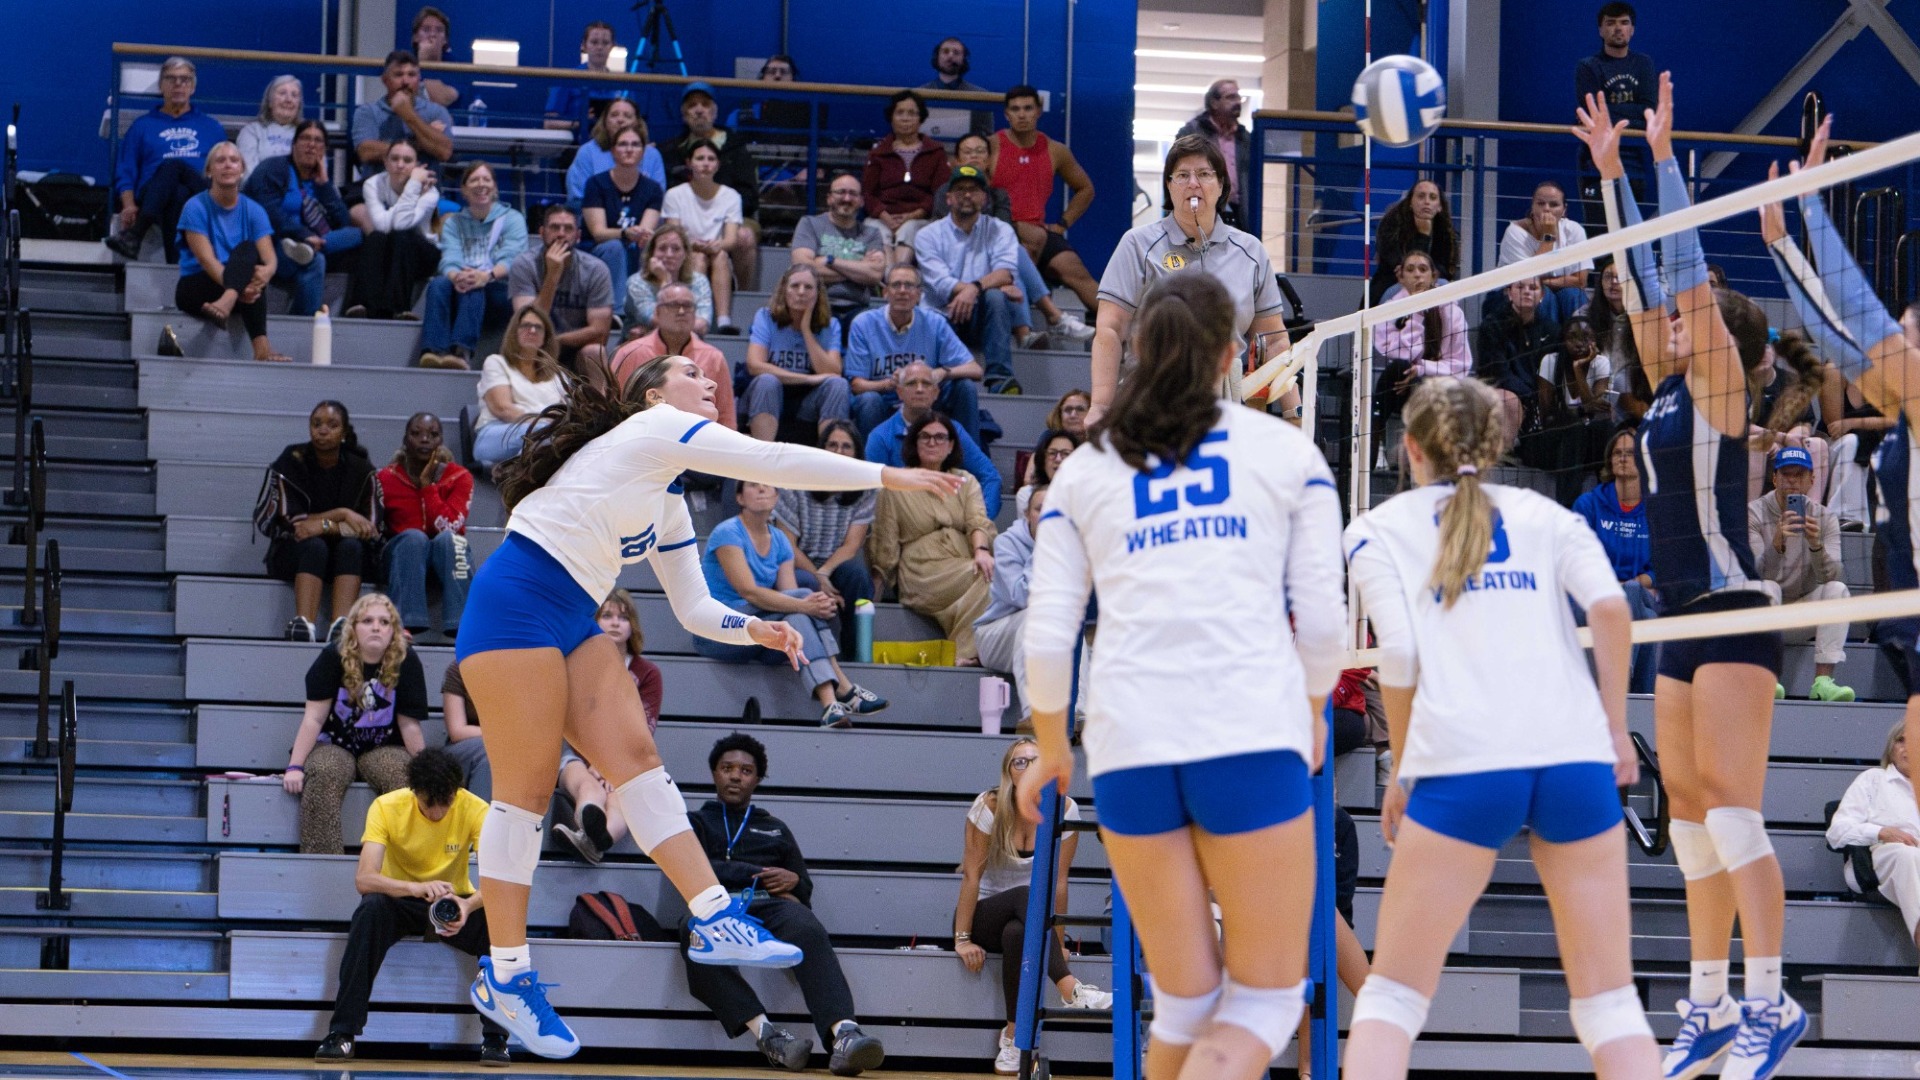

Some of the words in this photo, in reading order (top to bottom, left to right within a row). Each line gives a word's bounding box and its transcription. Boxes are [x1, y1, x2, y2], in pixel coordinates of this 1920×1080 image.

[768, 350, 810, 370] LASEL
[1132, 430, 1230, 519] 25
[1126, 515, 1248, 553] WHEATON
[1429, 571, 1537, 604] EATON
